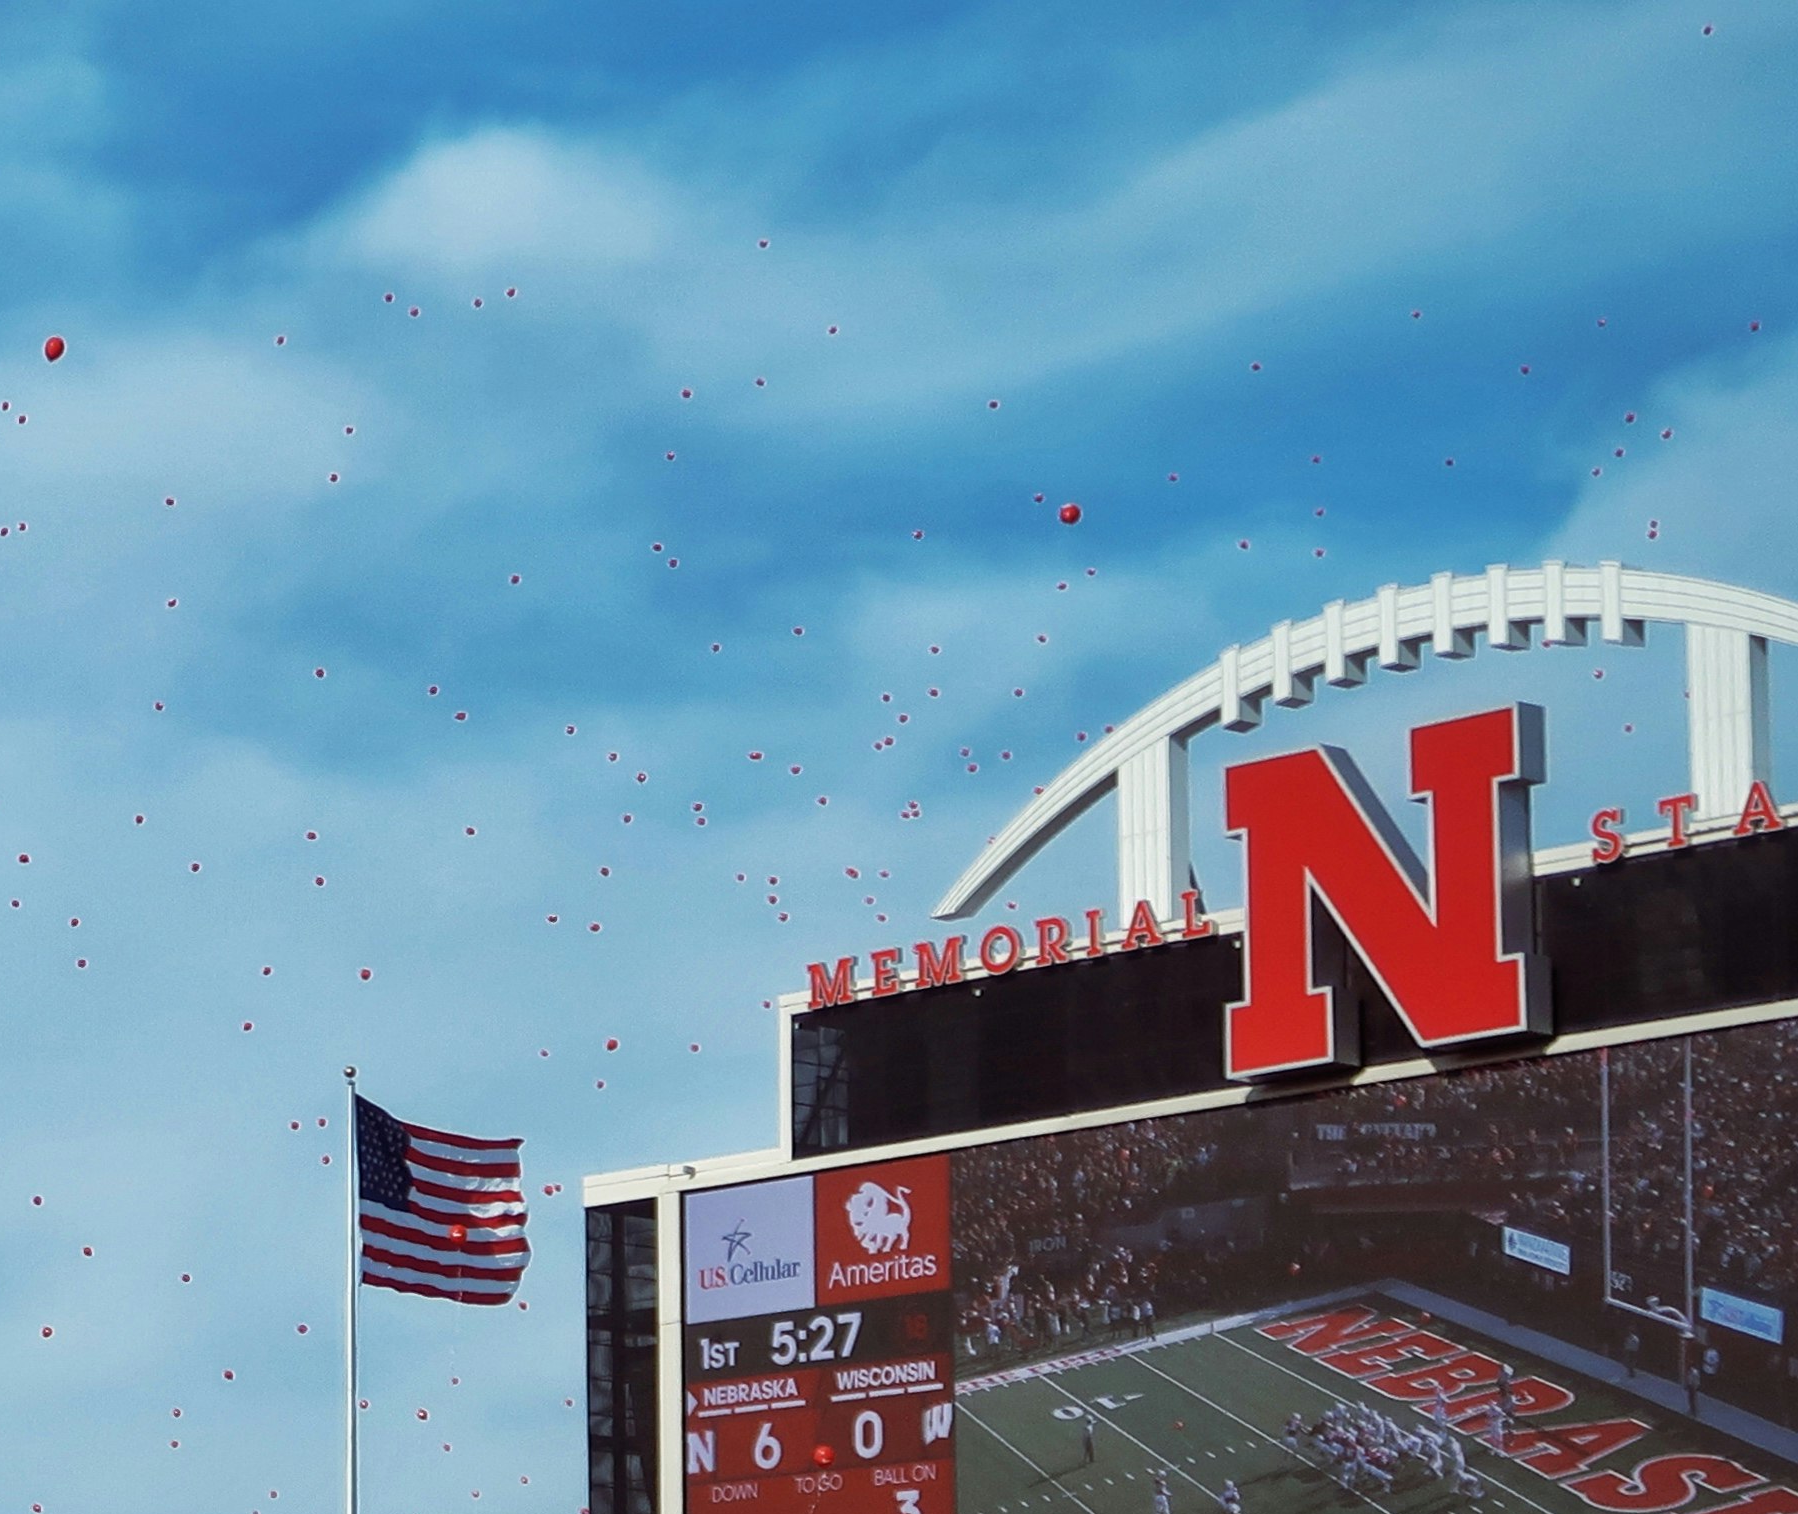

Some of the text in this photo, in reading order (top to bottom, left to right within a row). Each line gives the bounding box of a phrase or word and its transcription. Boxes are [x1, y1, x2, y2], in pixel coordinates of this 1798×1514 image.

[1224, 701, 1529, 1081] N
[807, 889, 1214, 1010] MEMORIAL
[730, 1258, 802, 1286] Cellular
[828, 1254, 937, 1290] Ameritas
[700, 1337, 740, 1370] 1ST
[771, 1312, 863, 1367] 5:27
[702, 1378, 799, 1407] NEBRASKA
[836, 1361, 936, 1391] WISCONSIN
[686, 1422, 782, 1475] N 6
[855, 1410, 884, 1459] 0
[794, 1473, 843, 1494] TO GO
[873, 1464, 937, 1487] BALL ON
[711, 1483, 758, 1503] DOWN
